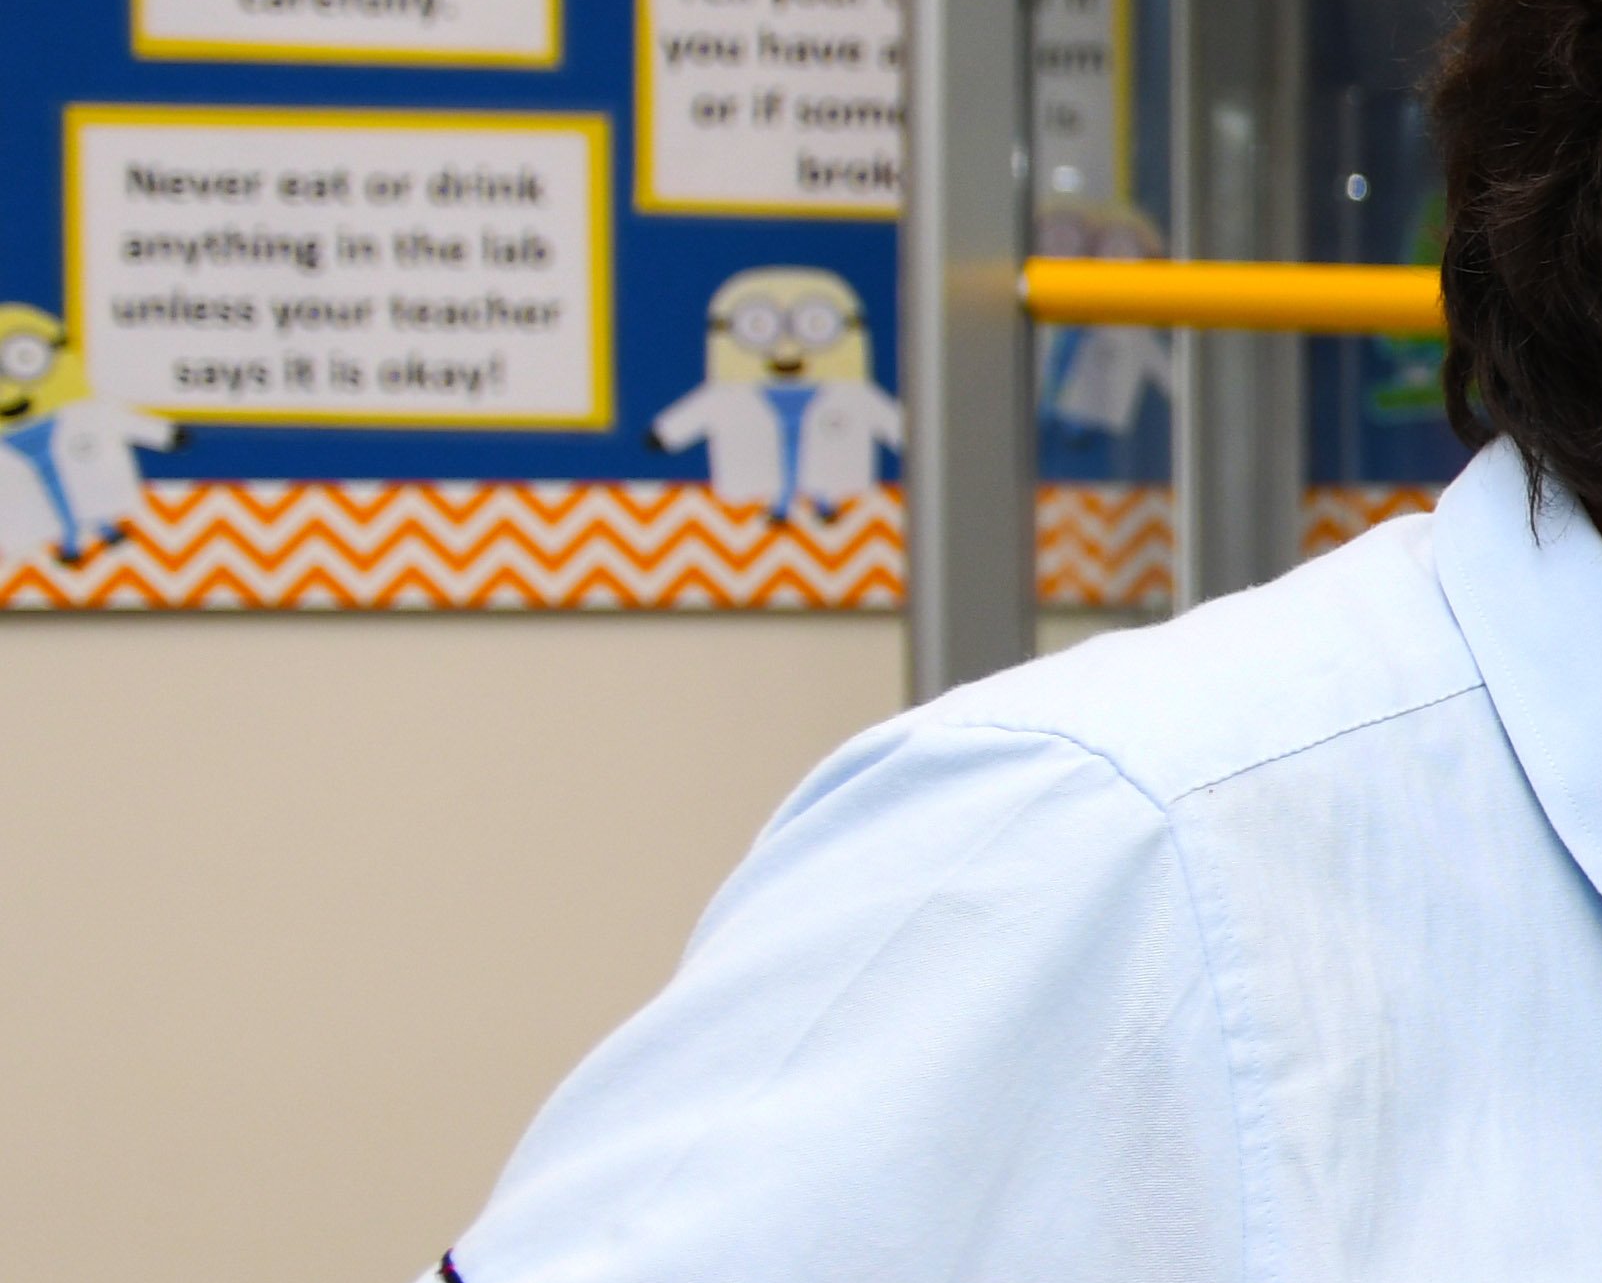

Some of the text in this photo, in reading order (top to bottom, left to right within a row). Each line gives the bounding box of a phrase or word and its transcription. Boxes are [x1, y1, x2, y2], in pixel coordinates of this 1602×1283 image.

[662, 33, 745, 69] you
[757, 31, 865, 69] have
[690, 96, 738, 128] or
[752, 88, 784, 126] if
[125, 166, 543, 205] Never eat or drink
[121, 230, 552, 272] anything in the lab
[112, 294, 560, 332] unless your teacher
[174, 356, 503, 395] says it is okay!
